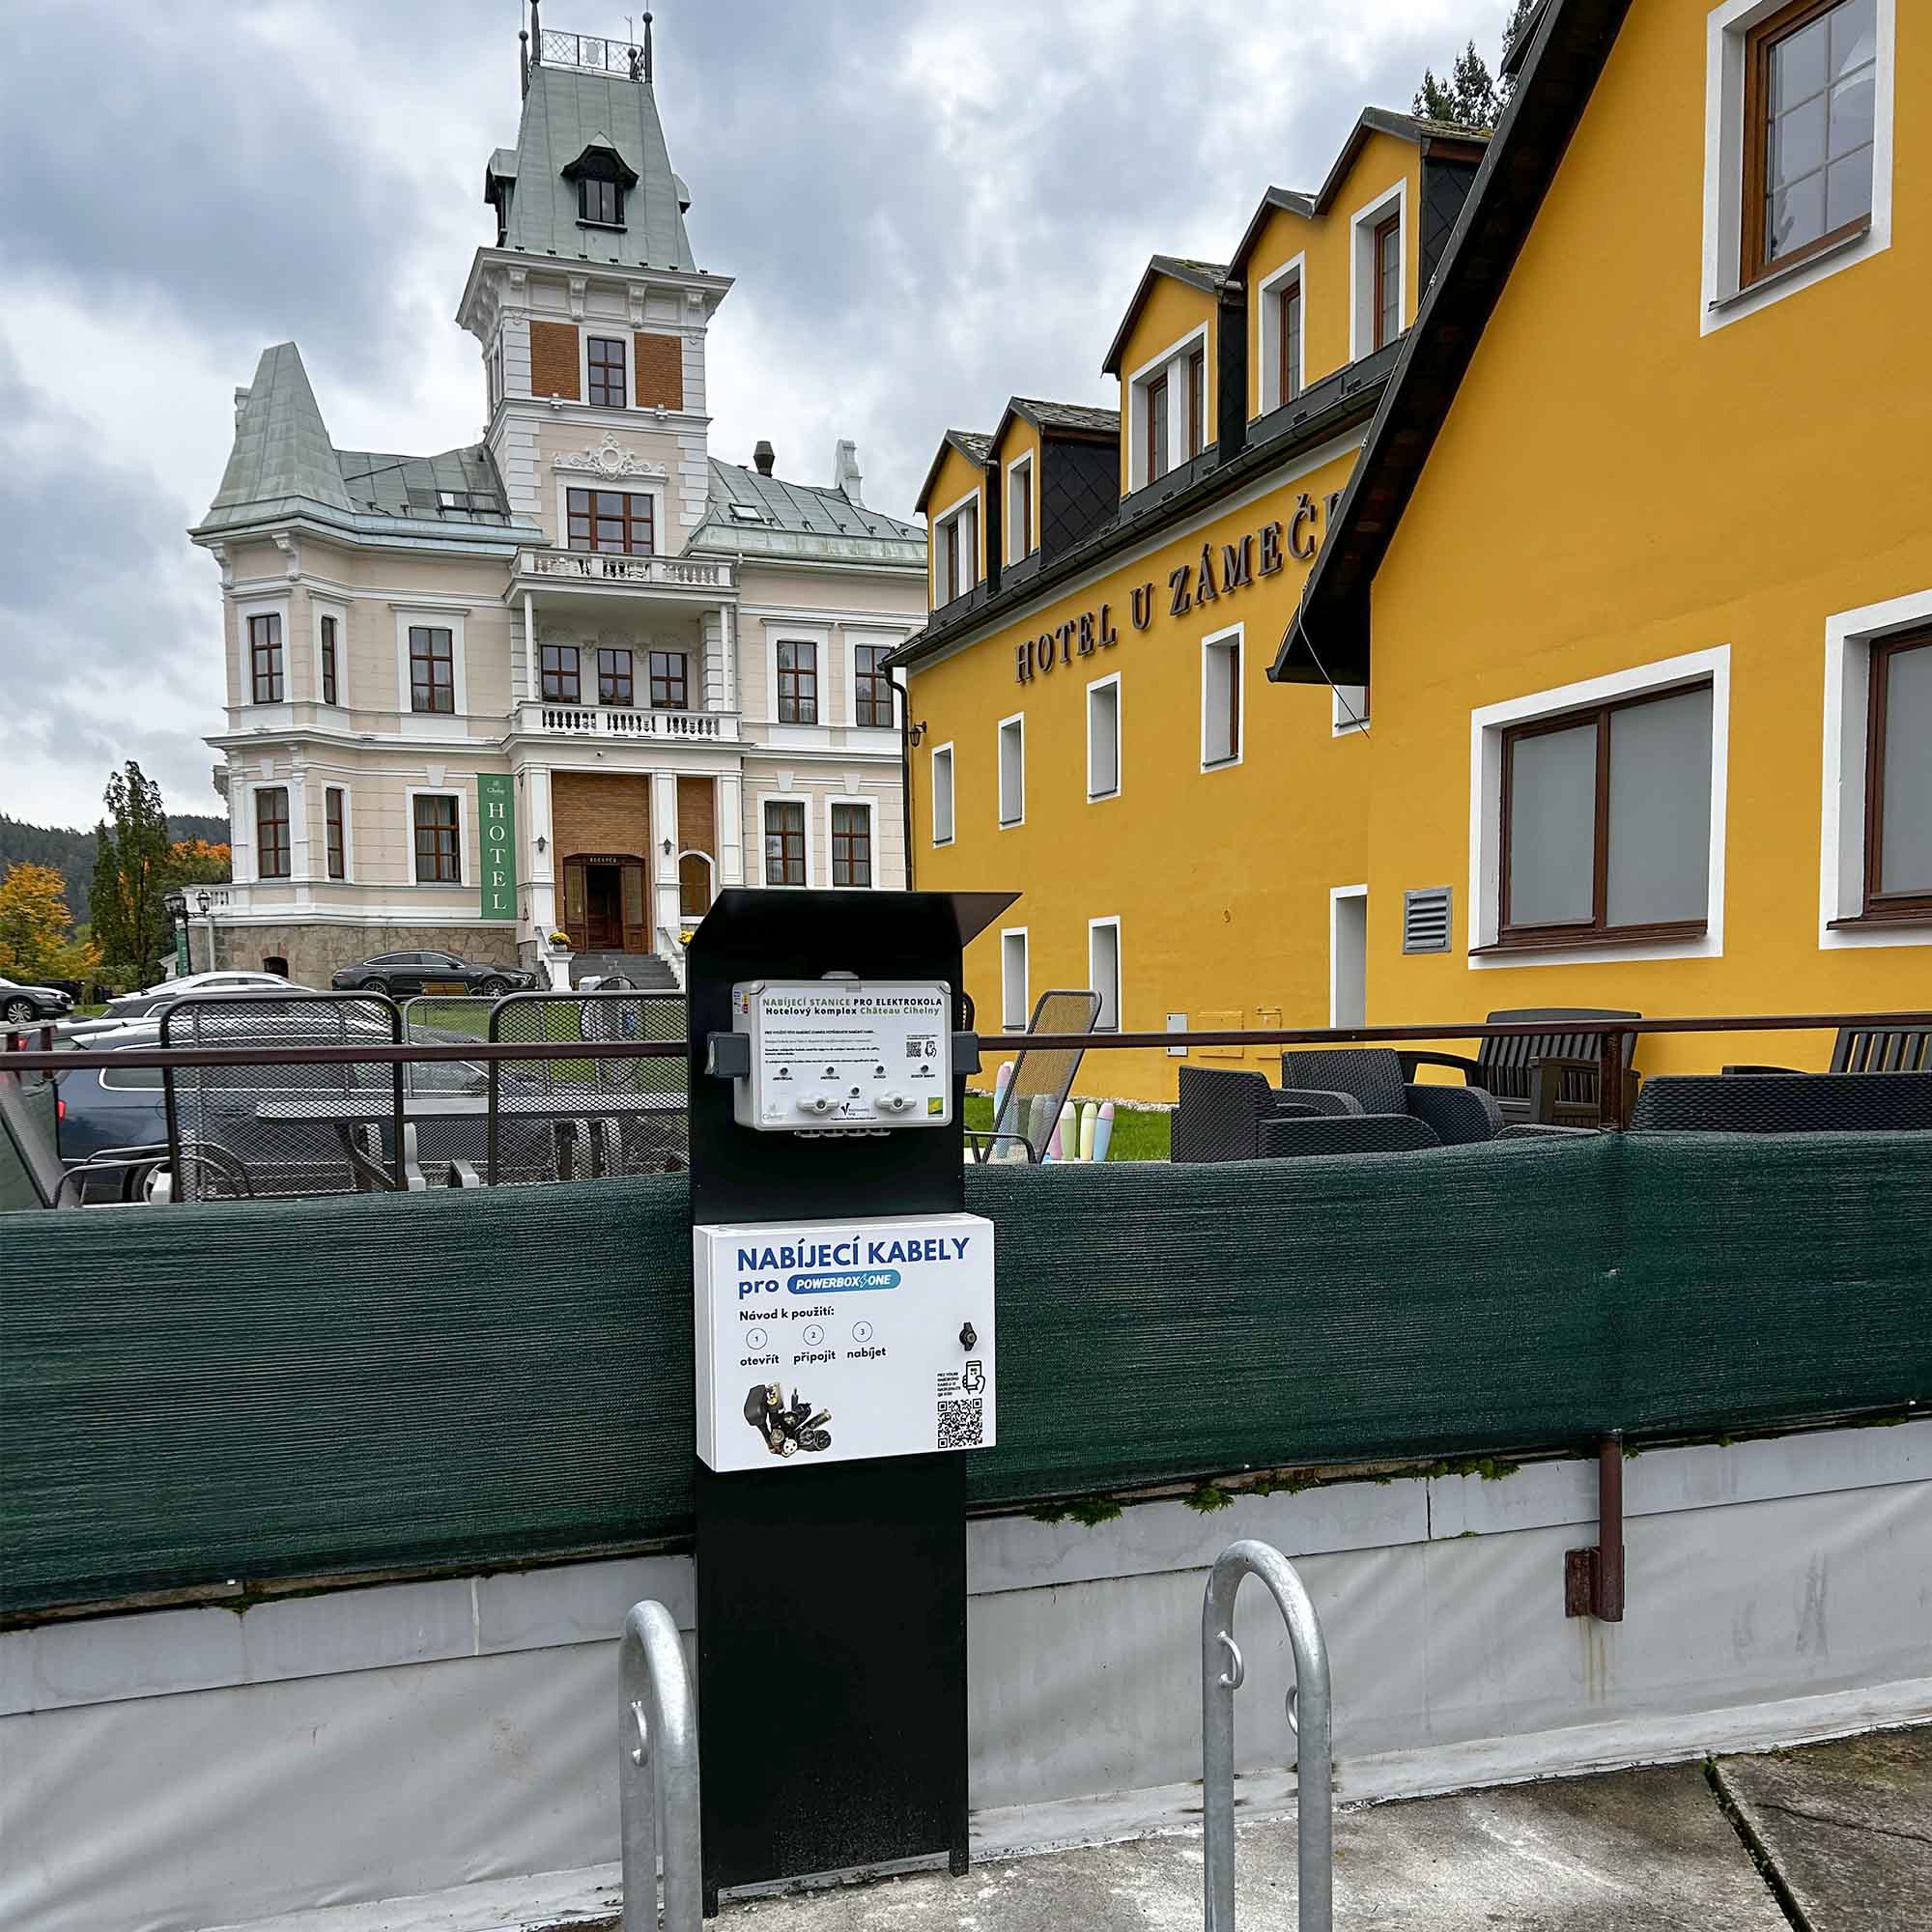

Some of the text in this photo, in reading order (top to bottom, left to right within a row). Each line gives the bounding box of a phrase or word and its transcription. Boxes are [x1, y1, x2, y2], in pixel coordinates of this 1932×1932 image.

[1014, 603, 1118, 684] HOTEL
[1129, 582, 1153, 630] U
[488, 802, 508, 911] HOTEL
[762, 997, 807, 1008] NABÍJECÍ
[765, 1007, 811, 1016] Hotelový
[814, 1007, 857, 1016] komplex
[903, 1006, 940, 1015] Cihelny
[737, 1236, 971, 1271] NABÍJECÍ KABELY
[738, 1274, 892, 1299] pro POWERBOX ONE
[739, 1306, 835, 1321] Návod k použití:
[740, 1347, 887, 1366] otevřít připojit nabíjet
